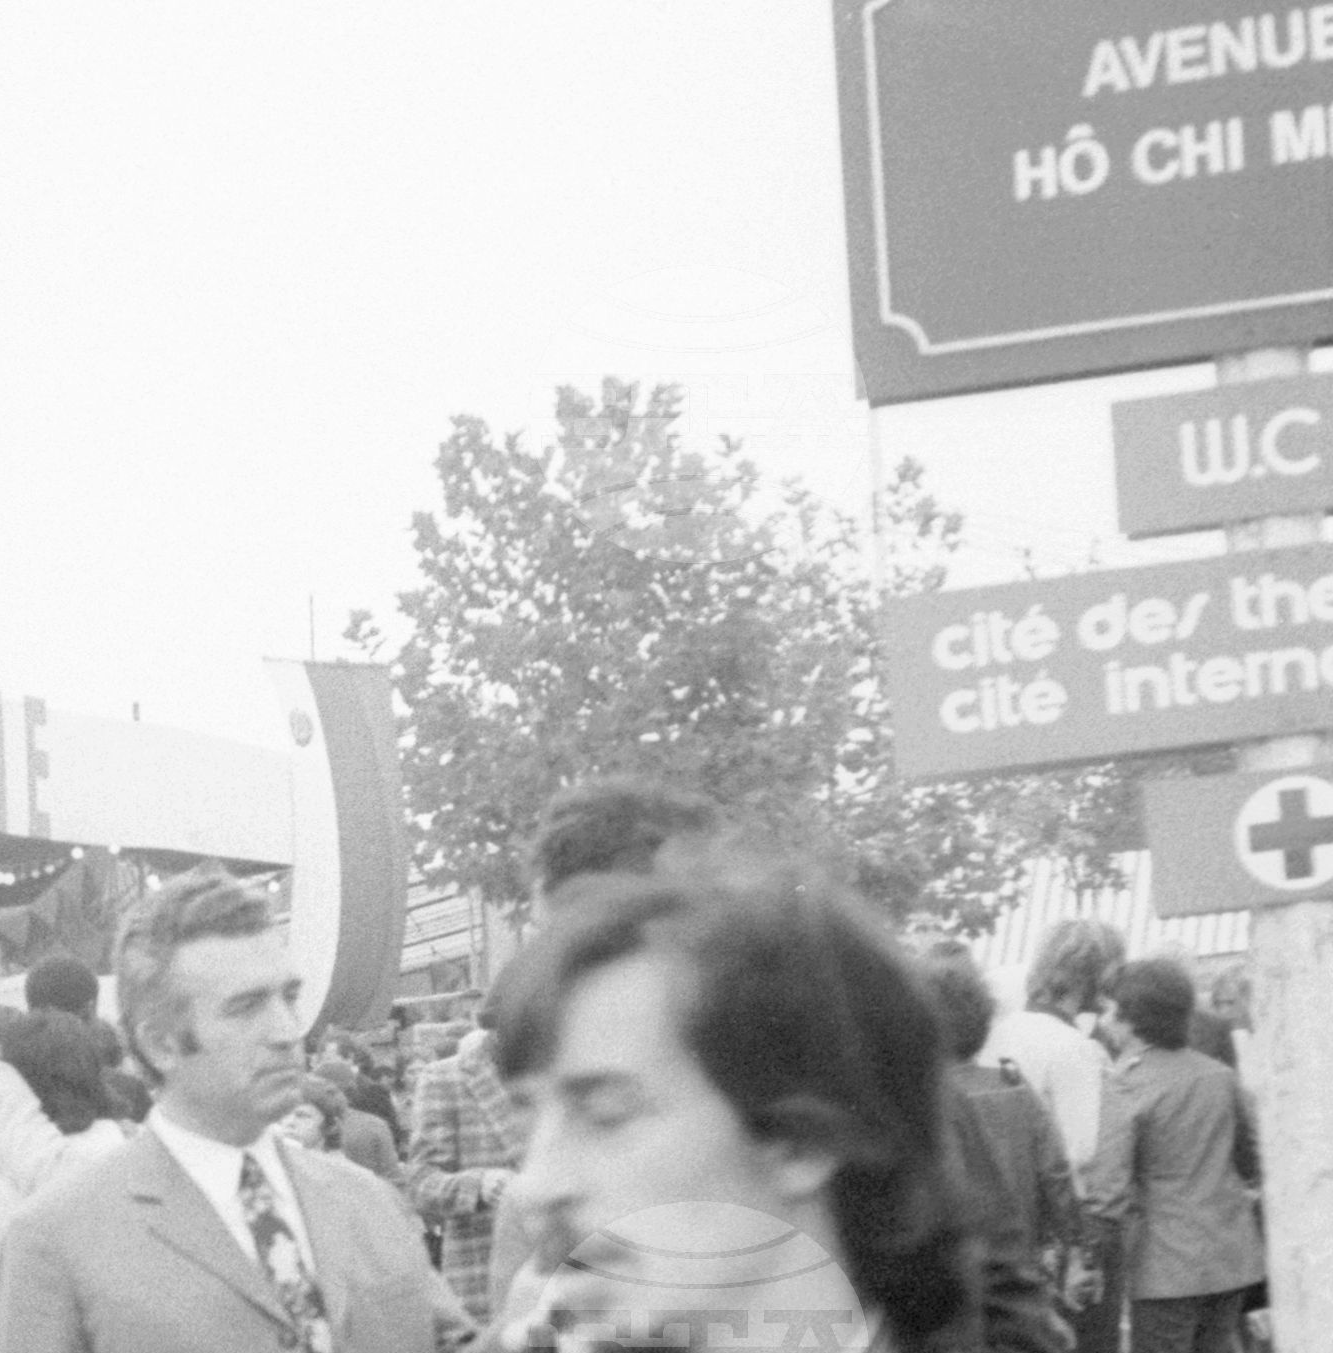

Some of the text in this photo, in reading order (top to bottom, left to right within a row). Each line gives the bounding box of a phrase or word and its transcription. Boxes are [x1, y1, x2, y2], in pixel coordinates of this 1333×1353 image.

[1082, 3, 1333, 98] AVENUE
[1014, 103, 1333, 201] HÔ CHI M
[933, 604, 1060, 670] cité
[940, 668, 1068, 732] cité
